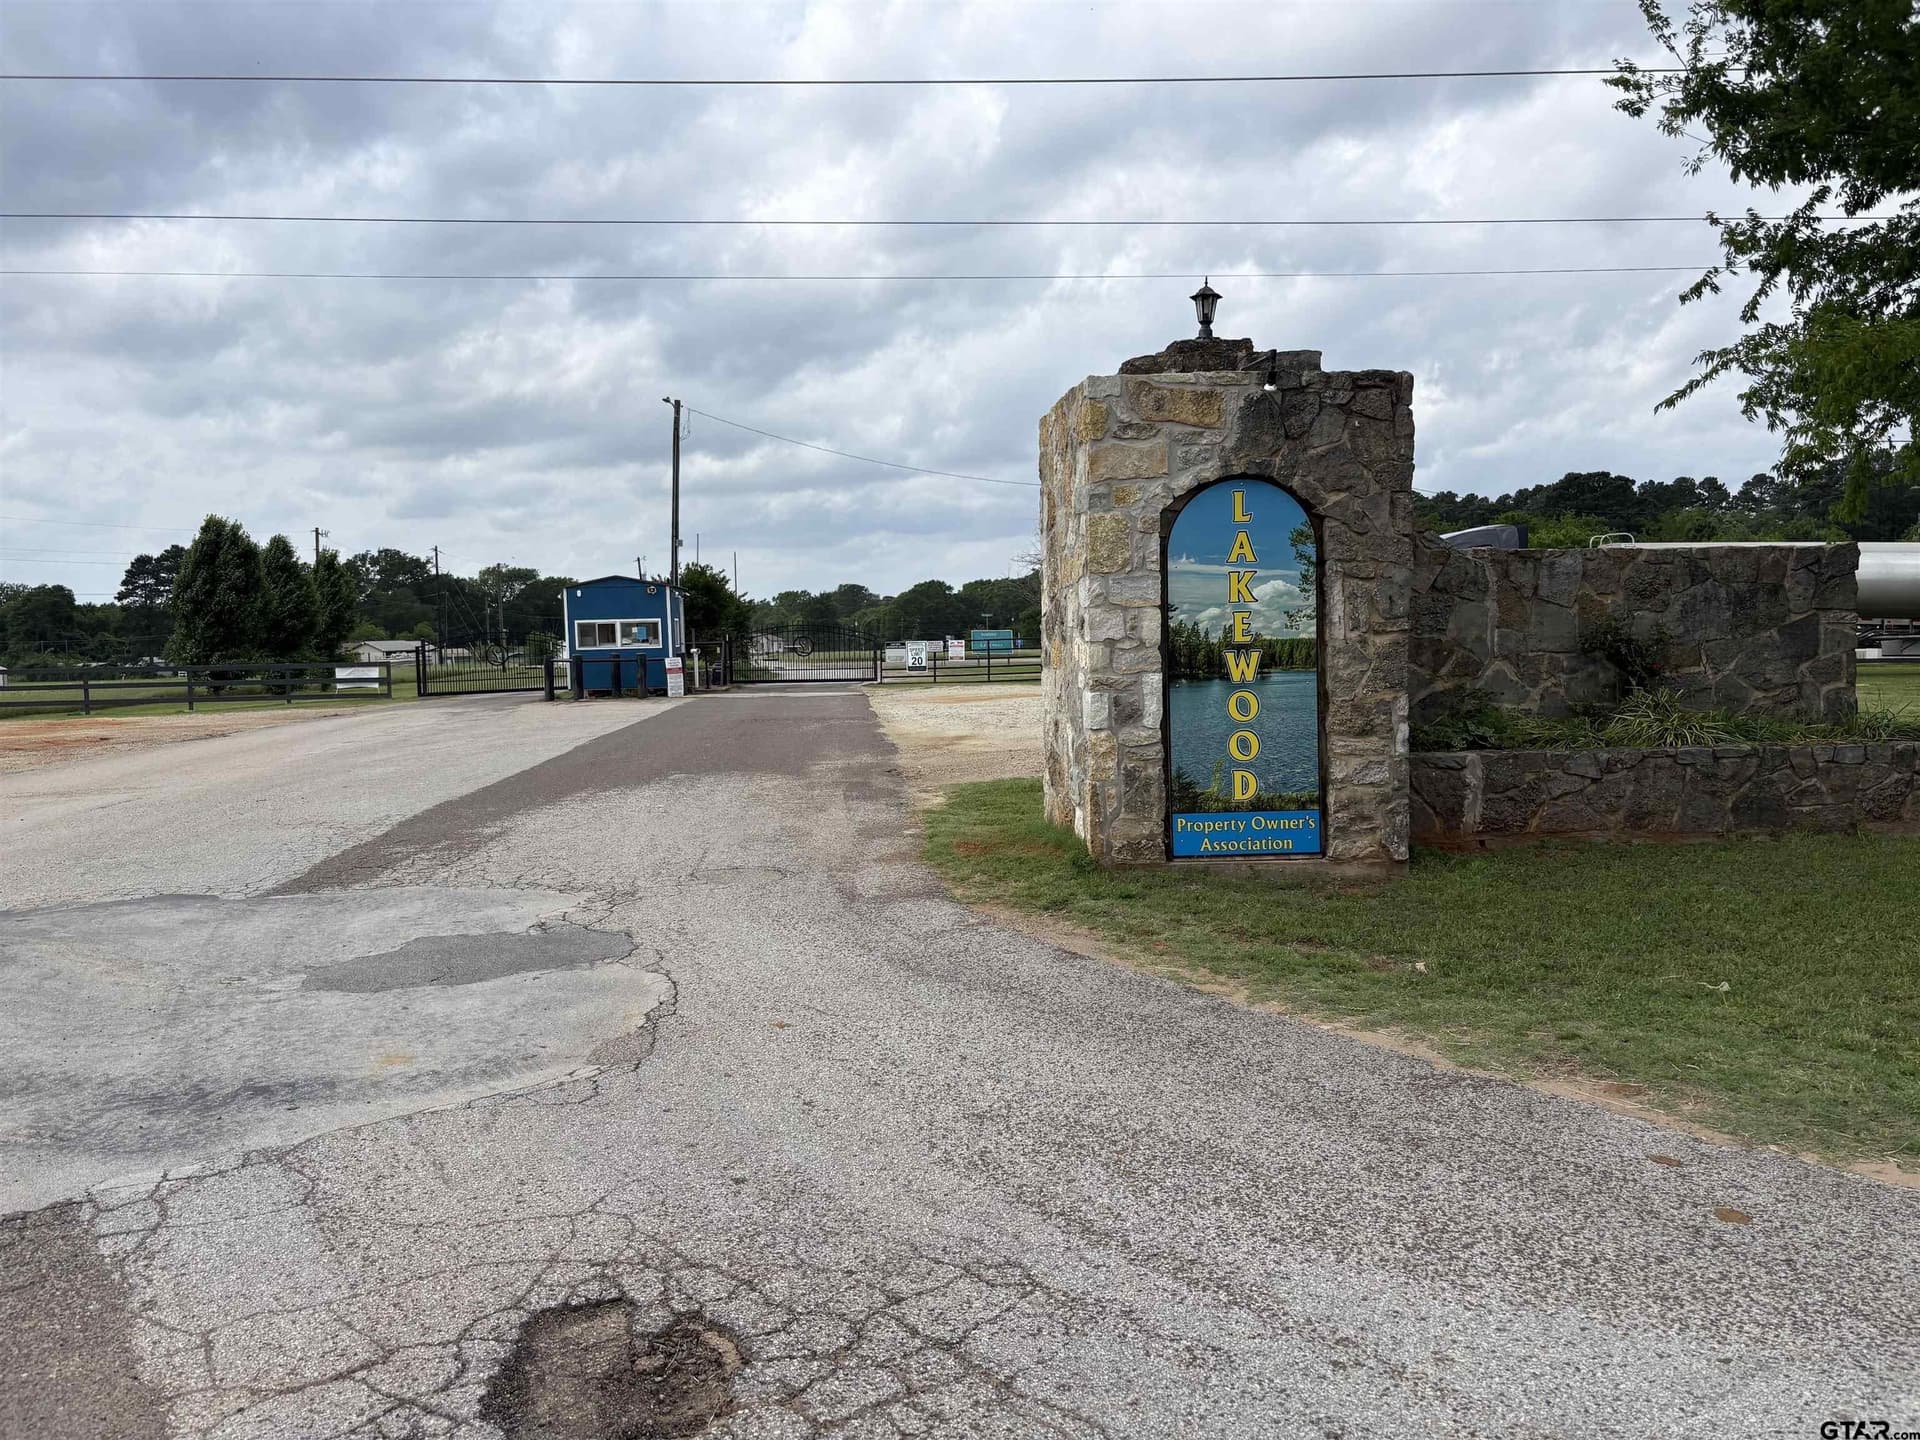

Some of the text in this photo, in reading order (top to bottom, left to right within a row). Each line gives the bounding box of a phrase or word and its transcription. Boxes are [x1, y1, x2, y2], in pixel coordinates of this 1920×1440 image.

[1224, 490, 1261, 802] LAKEWOOD
[911, 657, 923, 666] 20
[1176, 815, 1316, 834] Property Owner's
[1199, 836, 1294, 852] Association
